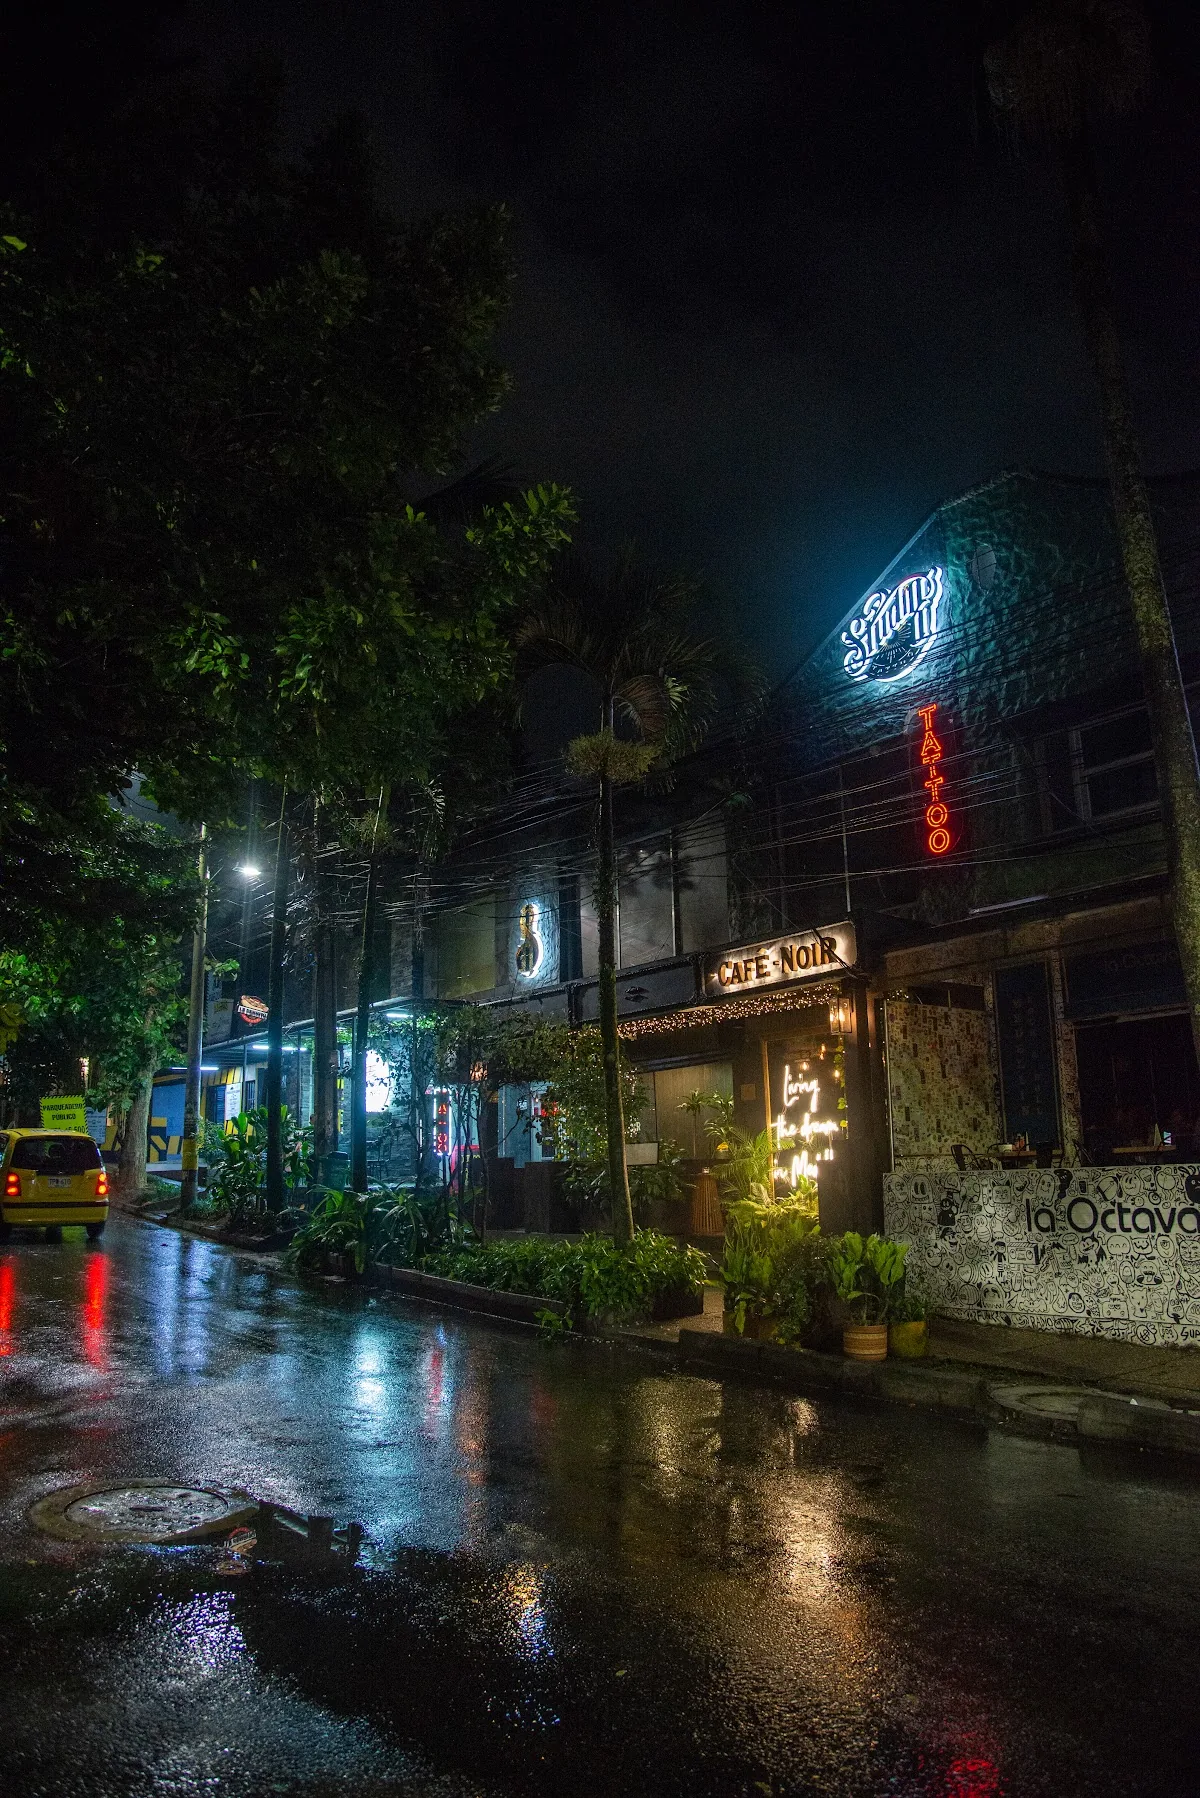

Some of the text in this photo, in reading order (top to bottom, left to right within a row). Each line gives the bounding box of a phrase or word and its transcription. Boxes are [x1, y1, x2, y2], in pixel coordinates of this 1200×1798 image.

[918, 703, 950, 853] TATTOO
[771, 1114, 798, 1150] the
[1025, 1196, 1200, 1234] la Octava
